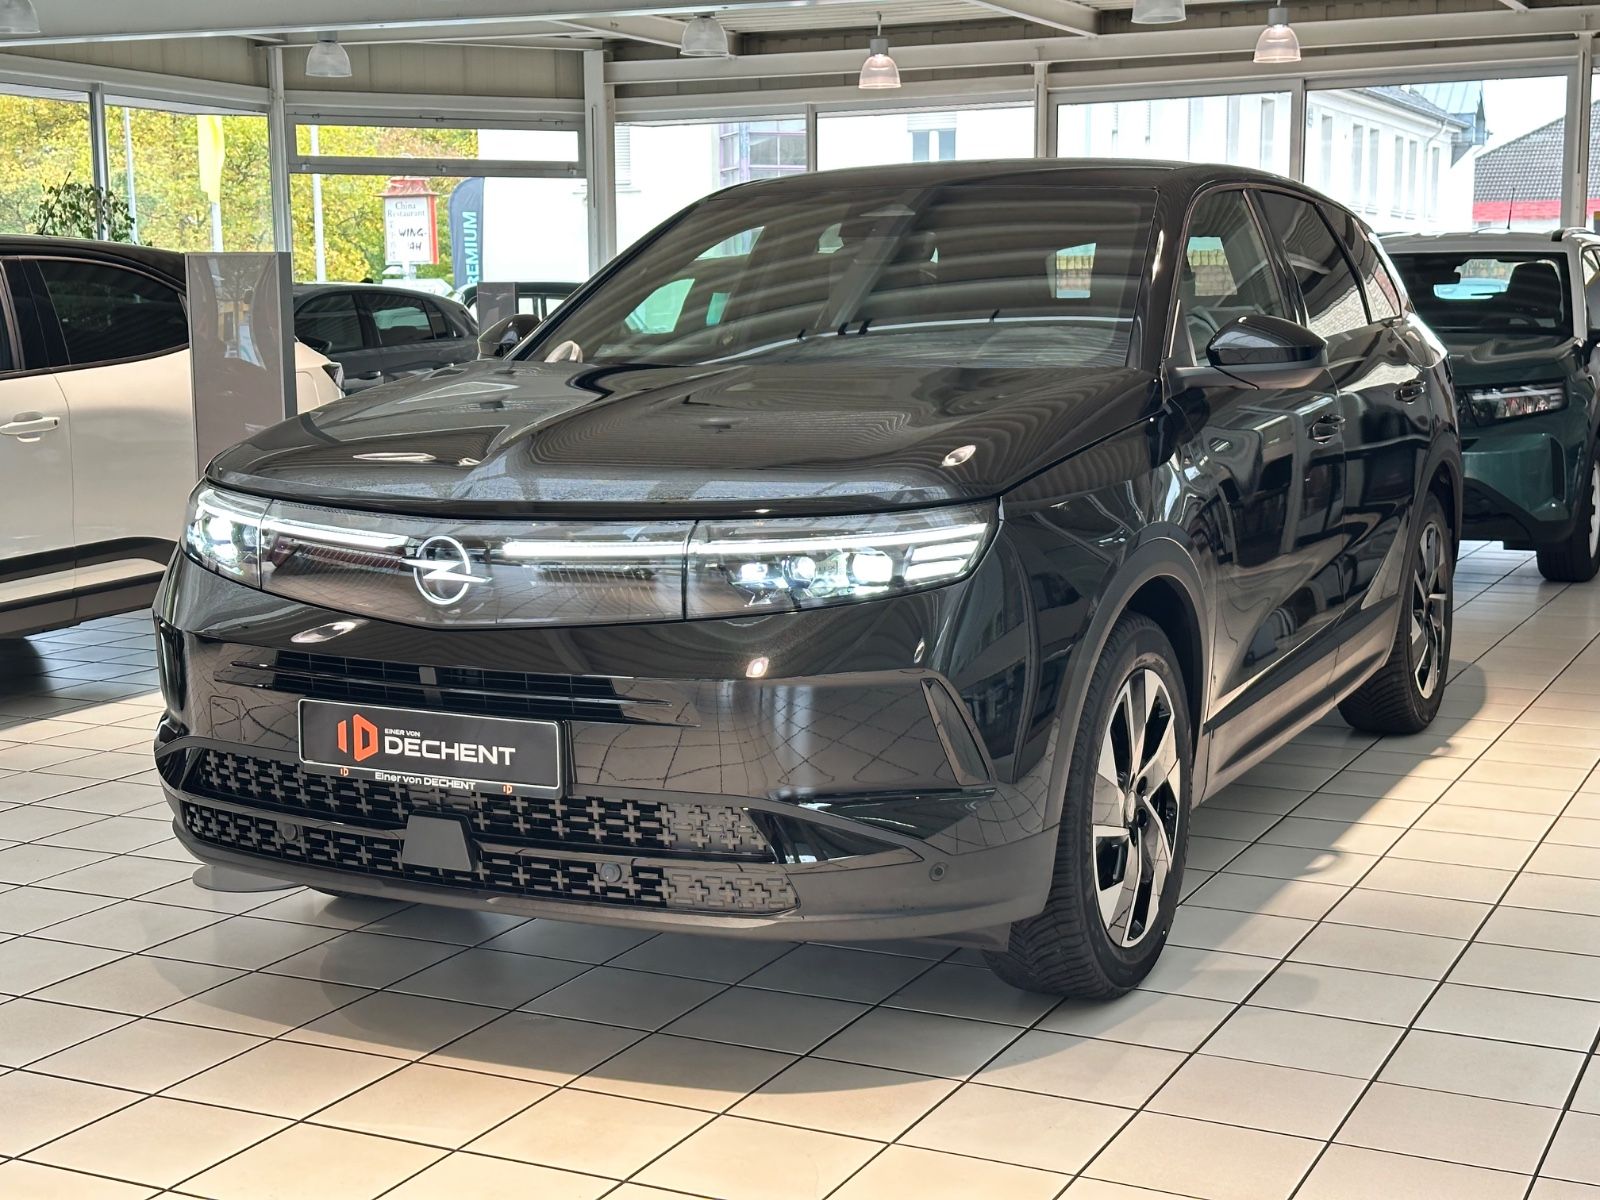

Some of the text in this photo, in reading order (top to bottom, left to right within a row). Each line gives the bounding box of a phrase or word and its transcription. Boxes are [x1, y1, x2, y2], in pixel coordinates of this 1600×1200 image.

[395, 201, 417, 210] China
[387, 209, 426, 217] Restaurant
[384, 728, 421, 738] EINER VON
[384, 736, 516, 766] DECHENT
[374, 771, 476, 790] Einer von DECHENT
